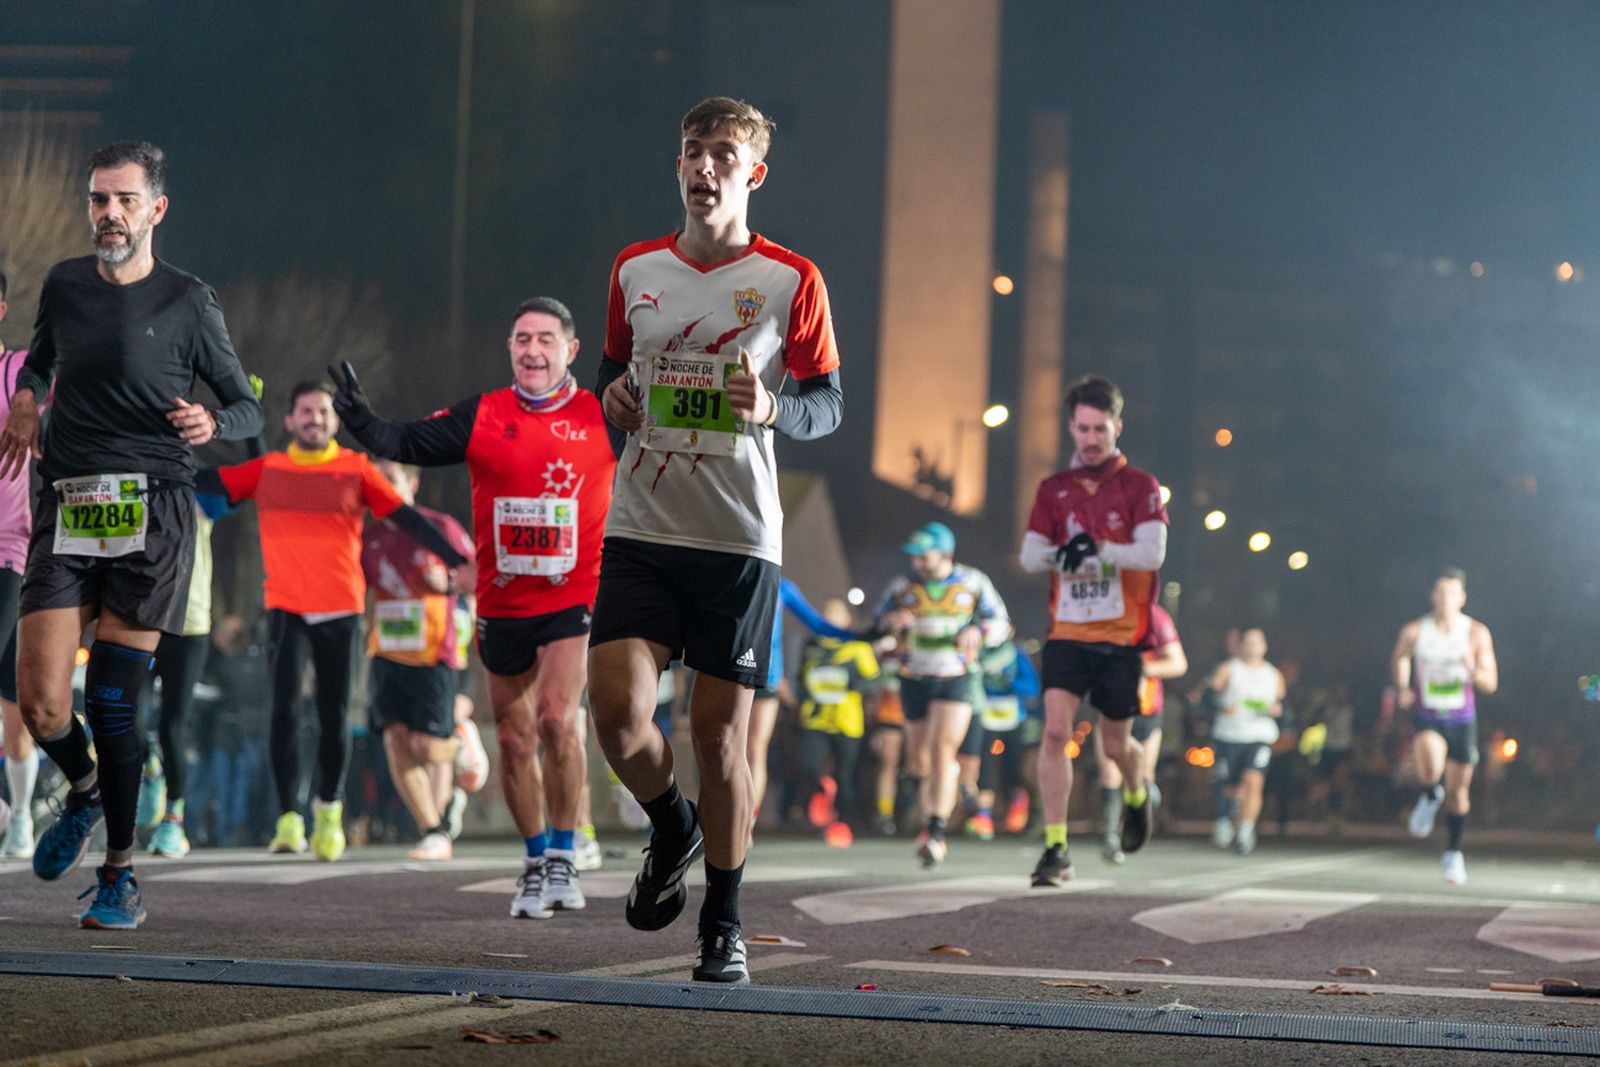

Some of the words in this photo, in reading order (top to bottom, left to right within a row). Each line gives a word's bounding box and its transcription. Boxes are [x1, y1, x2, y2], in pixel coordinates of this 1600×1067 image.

[670, 363, 700, 374] NOCHE
[701, 365, 714, 375] DE
[657, 374, 679, 385] SAN
[673, 388, 722, 420] 391
[100, 483, 111, 492] DE
[68, 495, 84, 504] SAN
[70, 503, 136, 529] 12284
[511, 526, 561, 549] 2387
[736, 658, 757, 668] adidas
